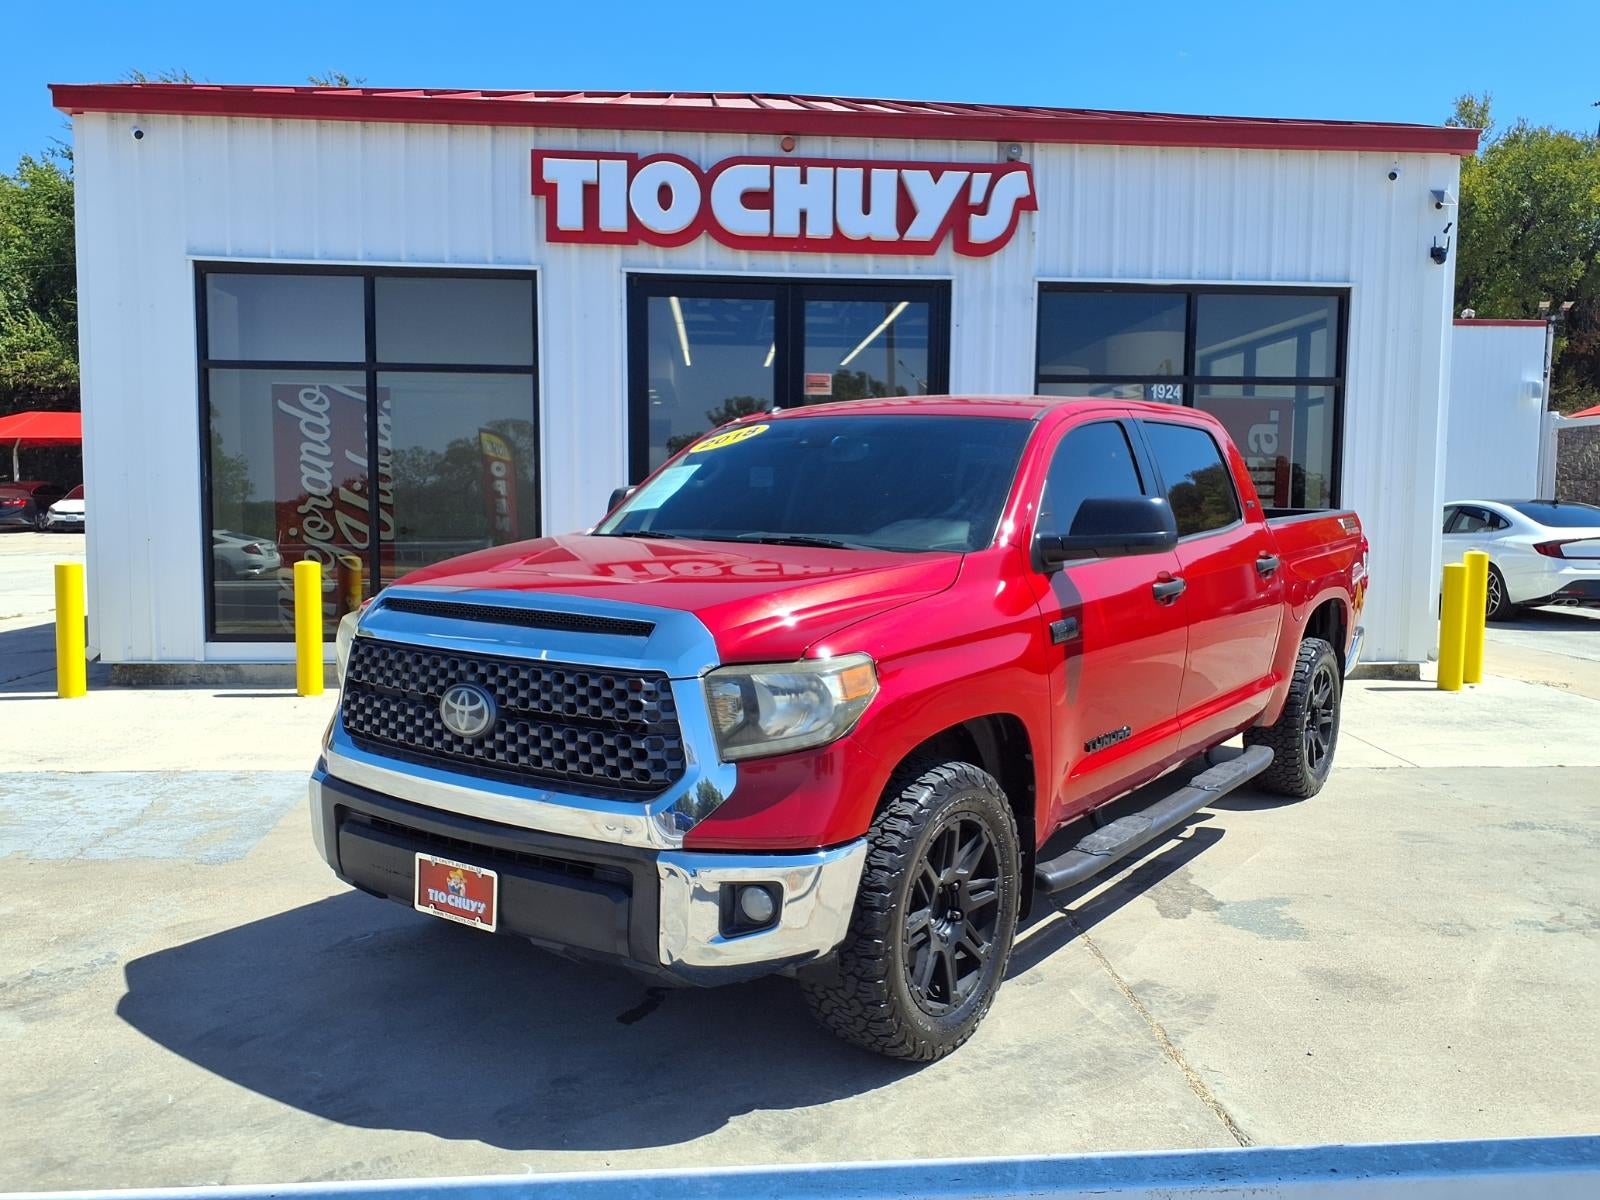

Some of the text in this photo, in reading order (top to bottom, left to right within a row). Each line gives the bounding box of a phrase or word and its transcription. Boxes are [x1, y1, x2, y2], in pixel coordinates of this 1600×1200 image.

[1151, 384, 1181, 399] 1924
[699, 427, 761, 449] 2018
[1083, 725, 1132, 753] TUNDRA
